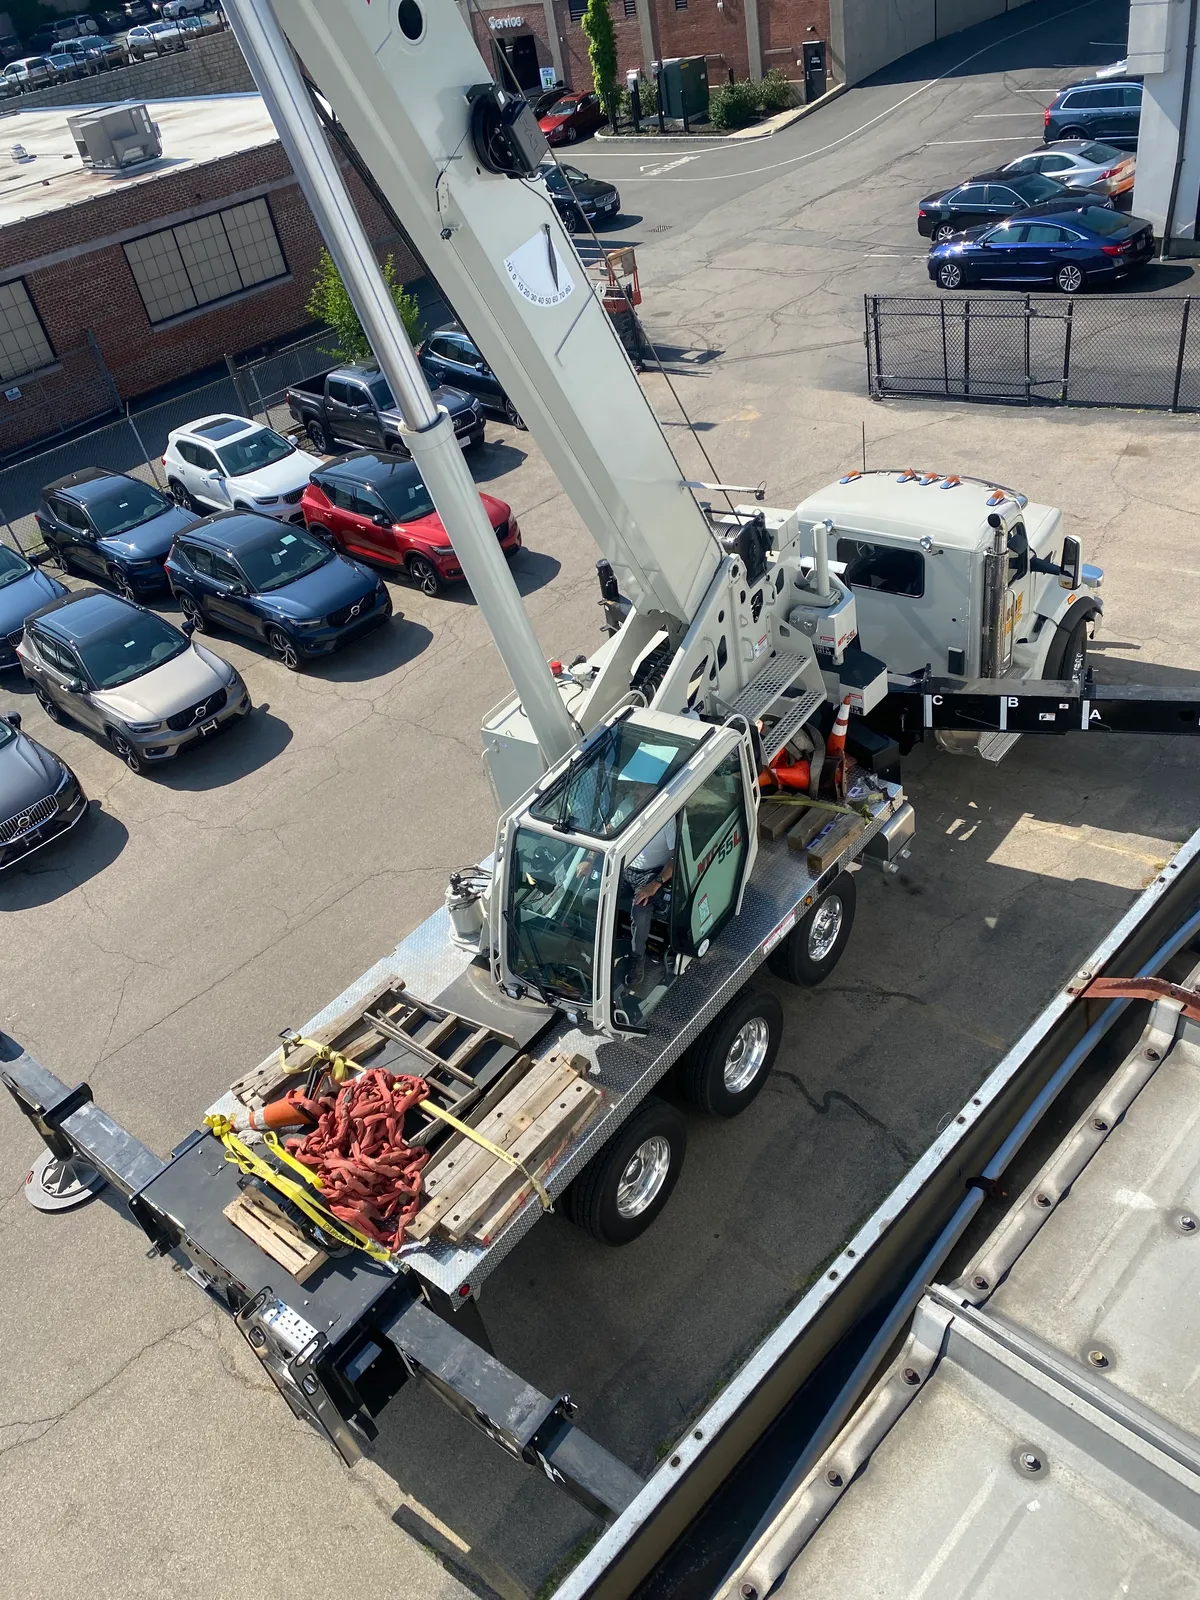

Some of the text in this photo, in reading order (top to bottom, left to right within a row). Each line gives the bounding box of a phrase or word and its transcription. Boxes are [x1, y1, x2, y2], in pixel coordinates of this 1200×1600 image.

[489, 14, 522, 29] Service
[518, 282, 524, 291] 10
[523, 289, 530, 298] 20
[531, 293, 537, 302] 30
[552, 295, 558, 303] 60
[559, 292, 565, 300] 70
[565, 285, 571, 294] 80
[932, 694, 943, 706] C
[1008, 697, 1019, 708] B
[1089, 709, 1102, 720] A
[718, 829, 743, 865] 55L
